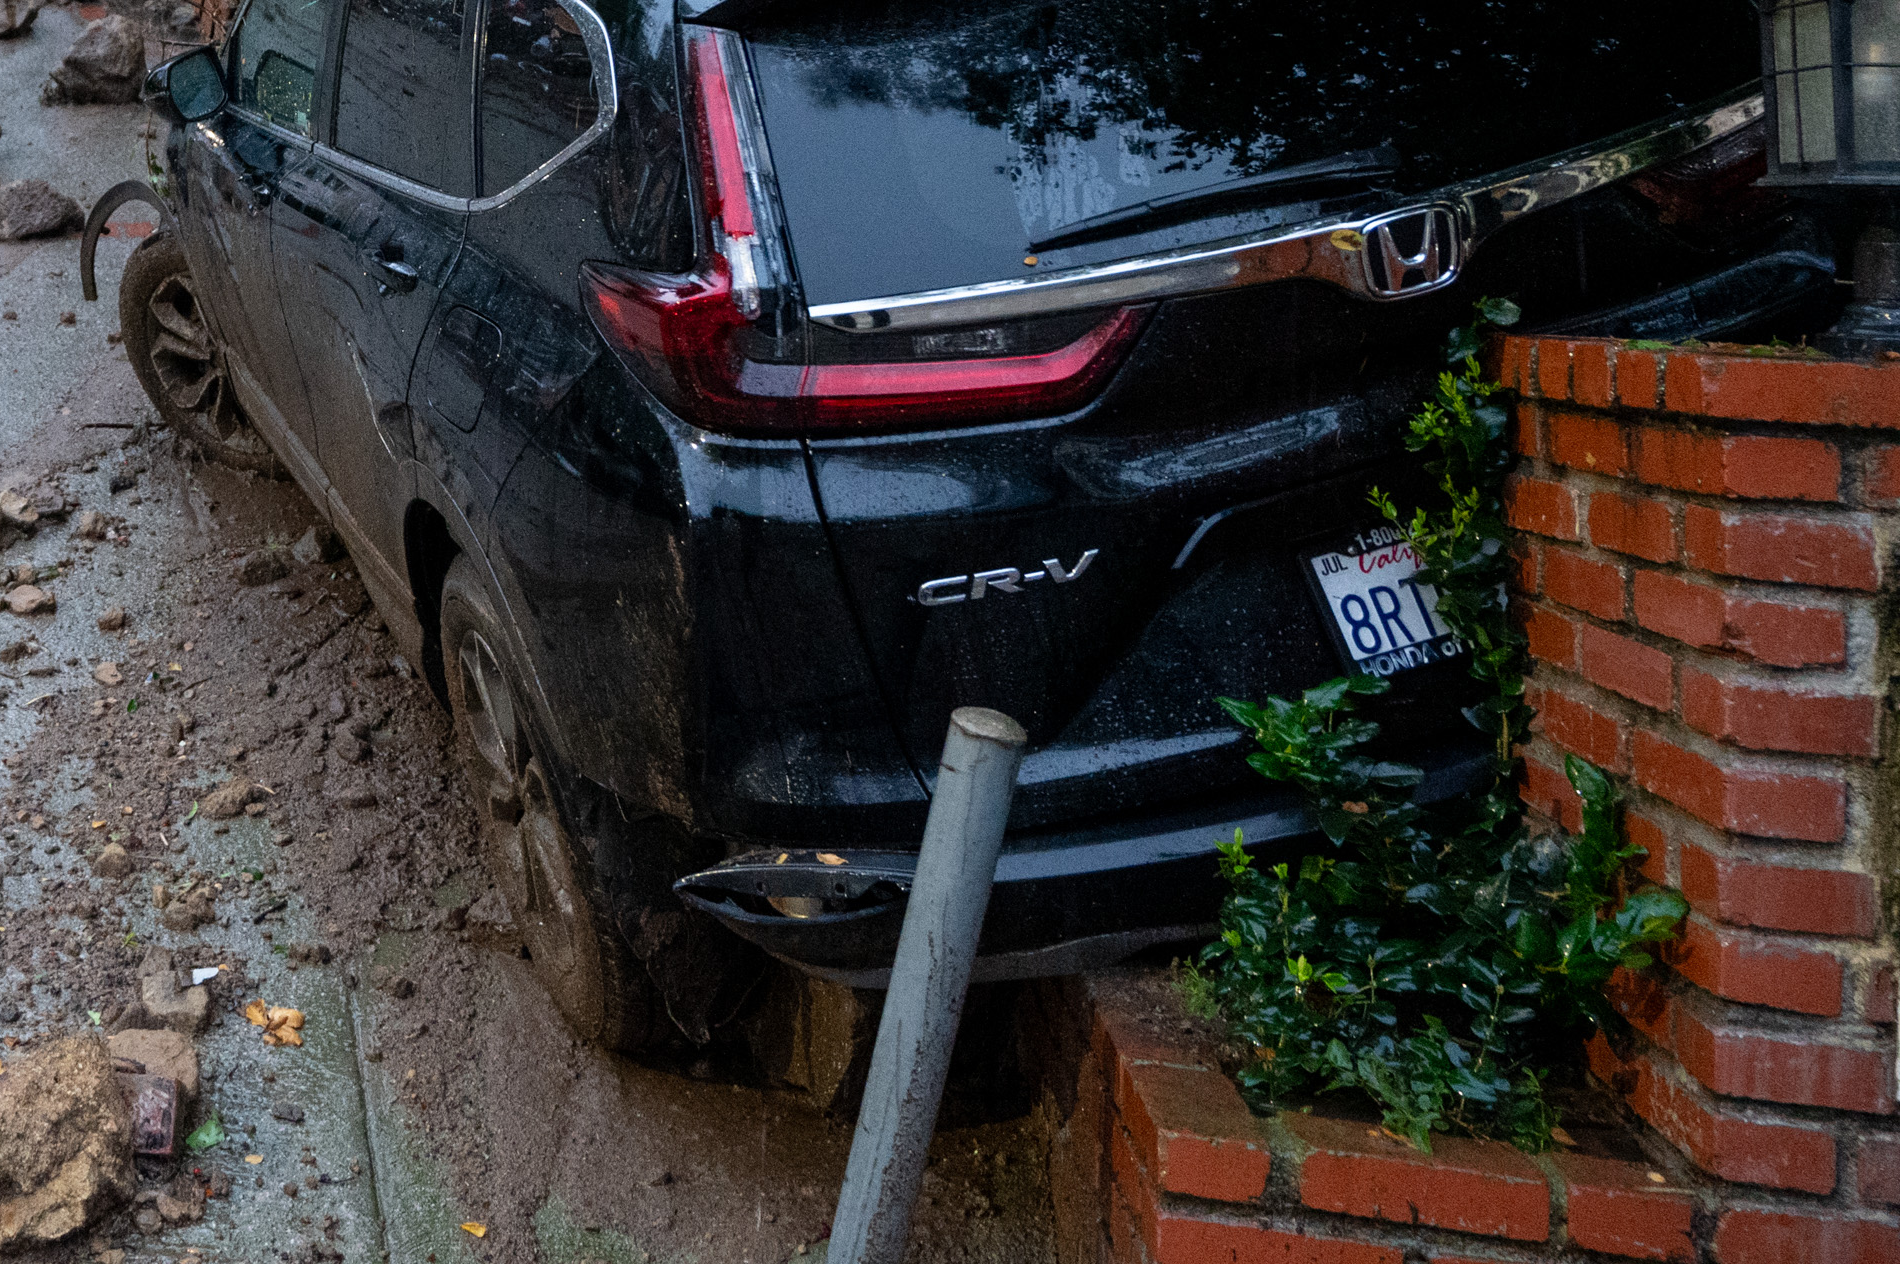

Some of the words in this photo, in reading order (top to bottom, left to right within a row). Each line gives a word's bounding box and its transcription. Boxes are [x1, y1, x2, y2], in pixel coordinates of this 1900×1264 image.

[917, 548, 1099, 608] CR-V
[1321, 557, 1348, 576] JUL
[1359, 642, 1440, 678] HONDA
